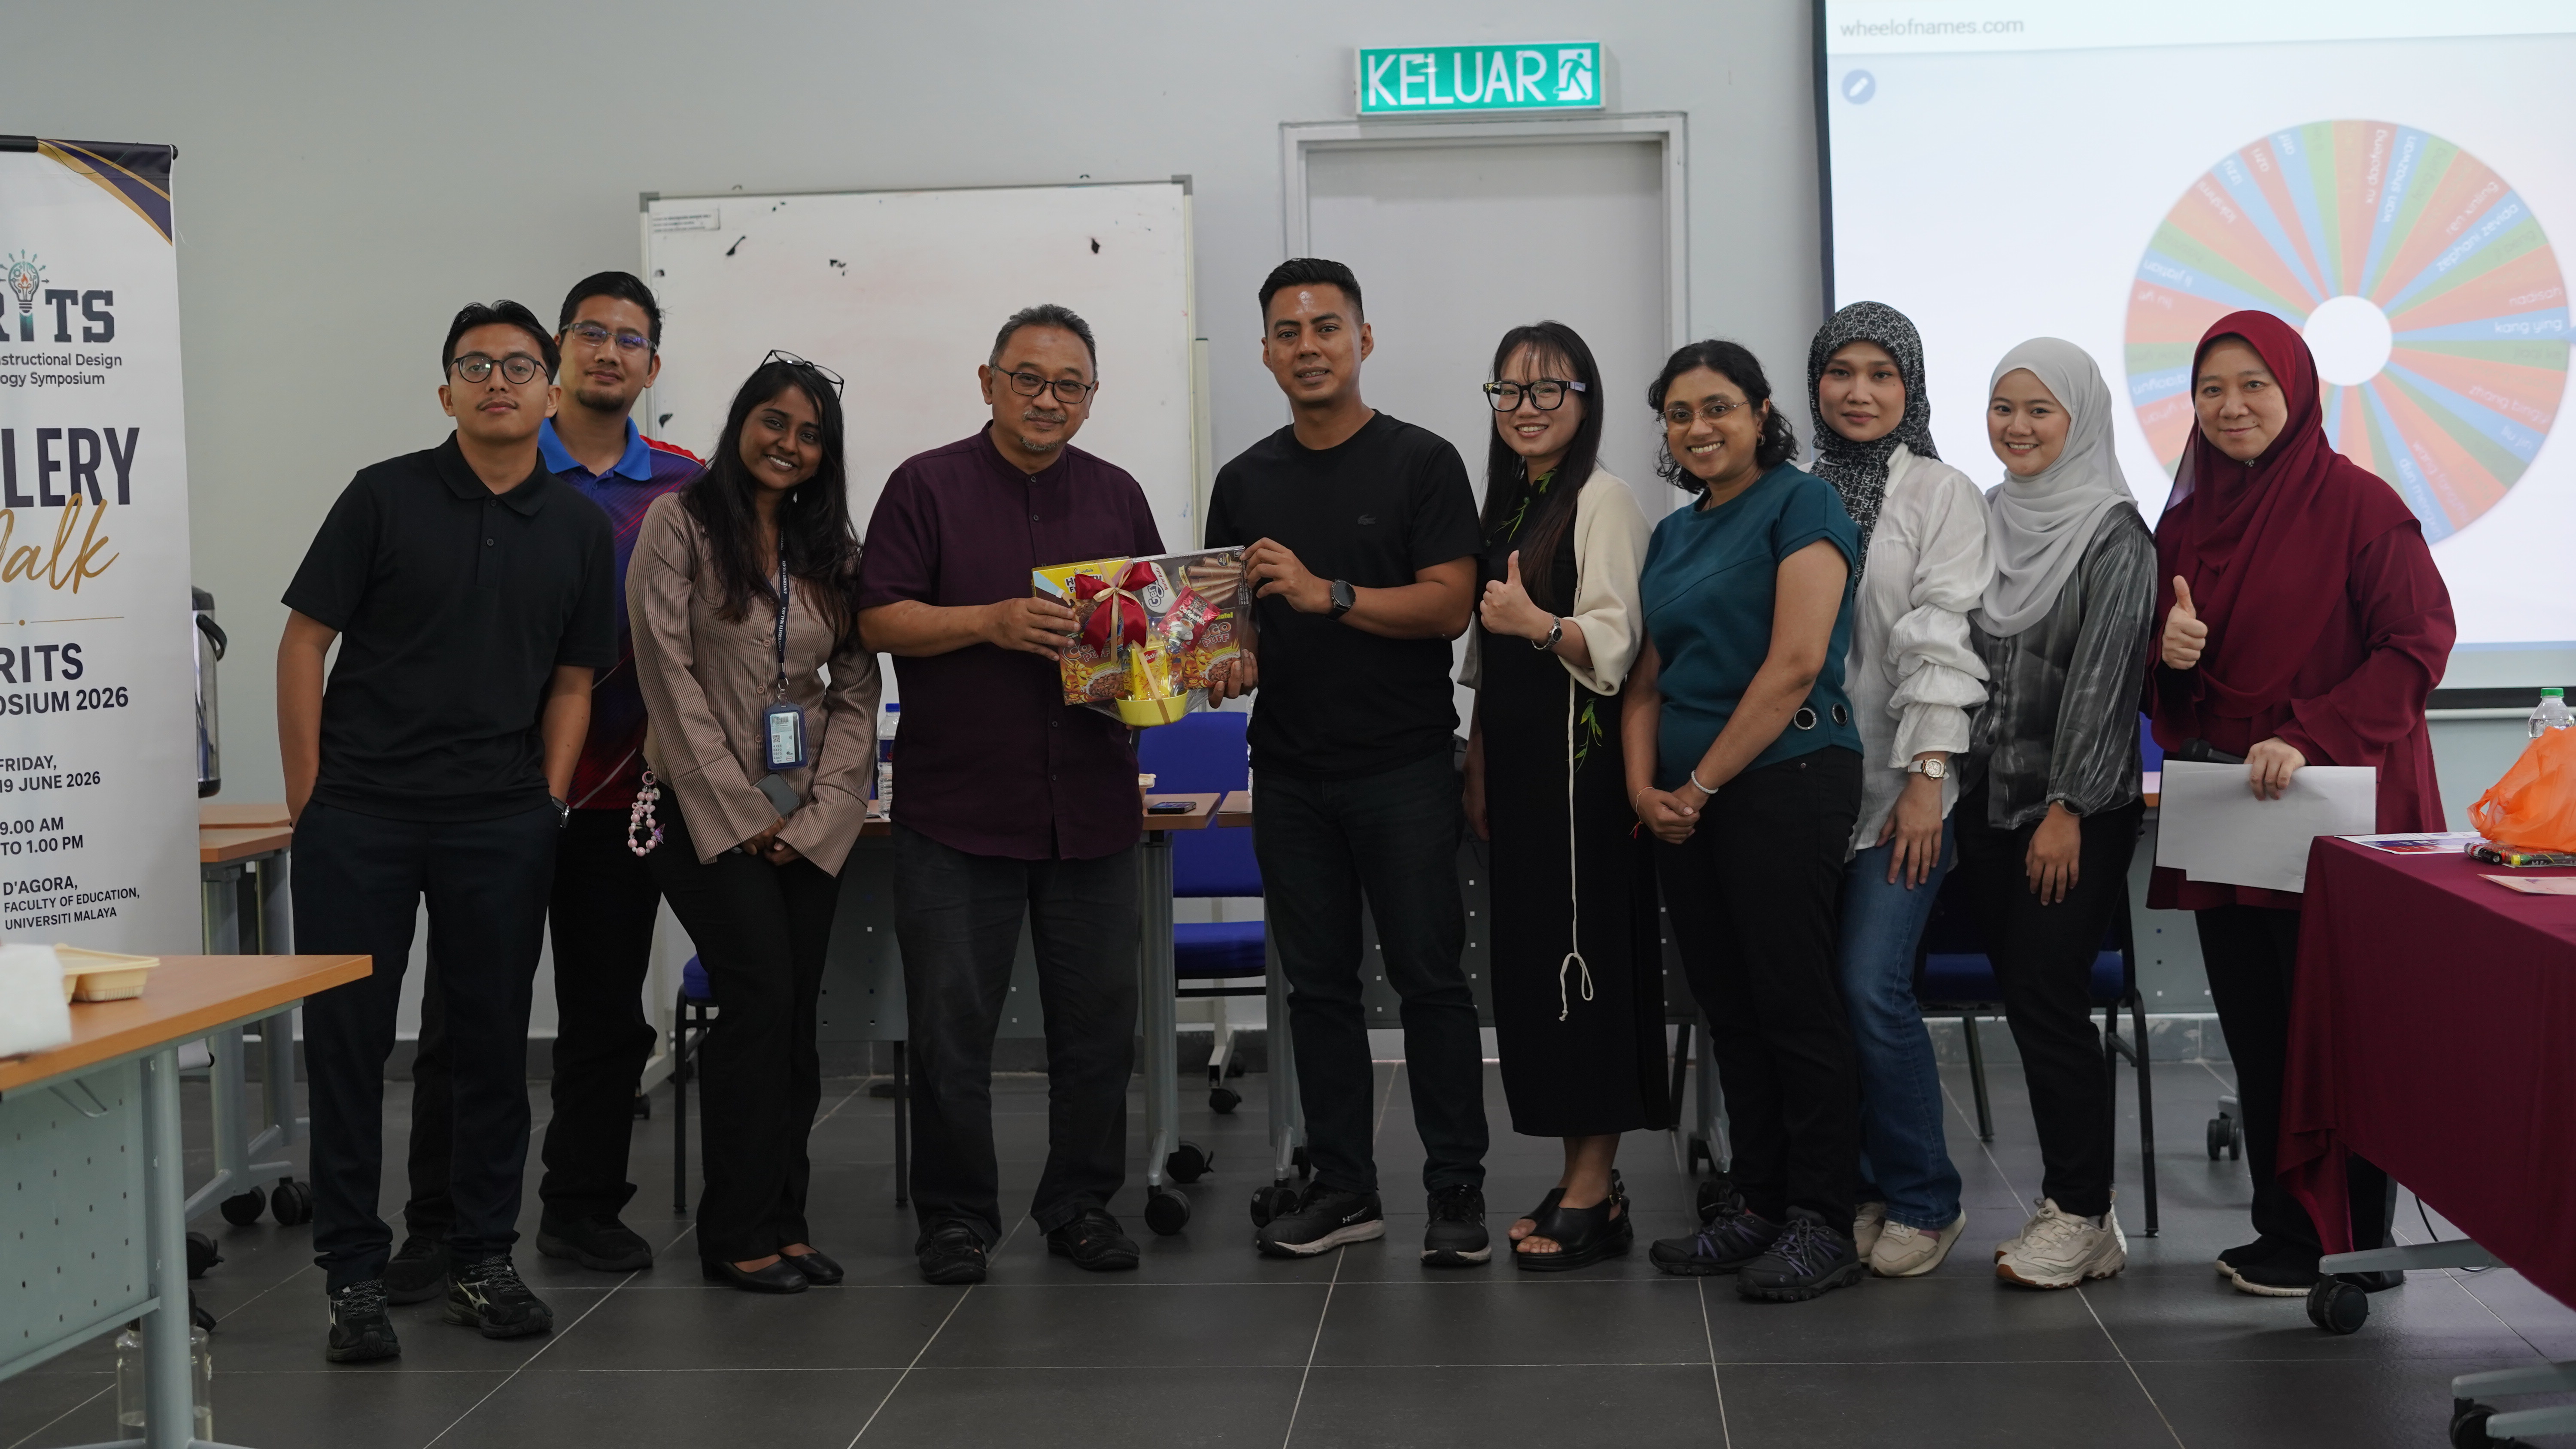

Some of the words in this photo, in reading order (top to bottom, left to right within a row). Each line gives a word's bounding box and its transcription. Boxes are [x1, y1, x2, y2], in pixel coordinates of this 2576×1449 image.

[1840, 18, 2024, 37] wheelofnames.com
[1367, 51, 1546, 106] KELUAR
[2390, 134, 2418, 192] shazwan
[2446, 215, 2465, 234] ren
[0, 285, 115, 343] ITS
[2494, 318, 2530, 334] kang
[2533, 315, 2563, 333] ying
[0, 352, 71, 366] structional
[76, 353, 122, 369] Design
[0, 374, 26, 387] ogy
[30, 371, 105, 387] Symposium
[1, 427, 140, 508] LERY
[2400, 458, 2418, 483] dun
[1202, 633, 1229, 648] PUFF
[0, 643, 83, 684] RITS
[76, 686, 128, 710] 2026
[18, 775, 62, 791] JUNE
[67, 771, 100, 788] 2026
[0, 819, 34, 835] 9.00
[39, 816, 64, 832] AM
[0, 841, 21, 855] TO
[26, 837, 58, 853] 1.00
[62, 834, 83, 850] PM
[3, 876, 78, 896] D'AGORA,
[4, 897, 56, 913] FACULTY
[60, 895, 73, 906] OF
[76, 887, 140, 904] EDUCATION,
[5, 912, 71, 930] UNIVERSITI
[74, 906, 117, 922] MALAYA
